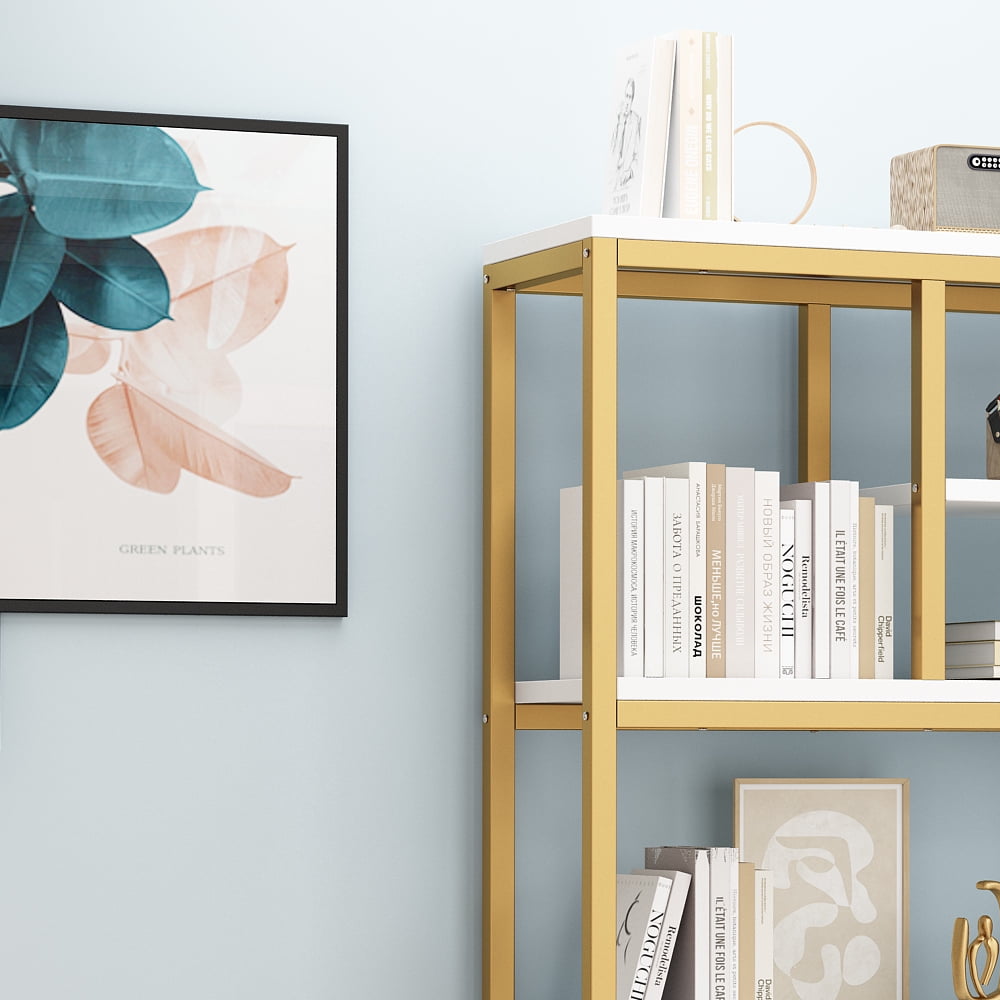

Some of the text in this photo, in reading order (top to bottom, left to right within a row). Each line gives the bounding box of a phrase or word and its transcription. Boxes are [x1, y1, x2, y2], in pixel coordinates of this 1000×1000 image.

[630, 509, 638, 539] ИСТОРИЯ
[118, 544, 225, 556] GREEN PLANTS
[671, 512, 682, 653] ЗАБОТА О ПРЕДАННЫХ
[762, 498, 774, 652] НОВЫЙ ОБРАЗ ЖИЗНИ
[781, 543, 795, 638] NOGUCHI
[801, 555, 811, 618] Remodelista
[835, 530, 847, 642] IL ÉTAIT UNE FOIS LE CAFÉ
[630, 594, 638, 624] ИСТОРИЯ
[630, 624, 638, 656] ЧЕЛОВЕКА
[692, 595, 702, 657] ШОКОЛАД
[711, 618, 722, 660] ЛУЧШЕ
[876, 615, 885, 663] Chipperfield
[885, 615, 893, 638] David
[715, 896, 724, 905] IL
[715, 907, 728, 931] ÉTAIT
[655, 926, 677, 986] Remodelista
[715, 932, 726, 950] UNE
[715, 952, 726, 971] FOIS
[715, 973, 726, 983] LE
